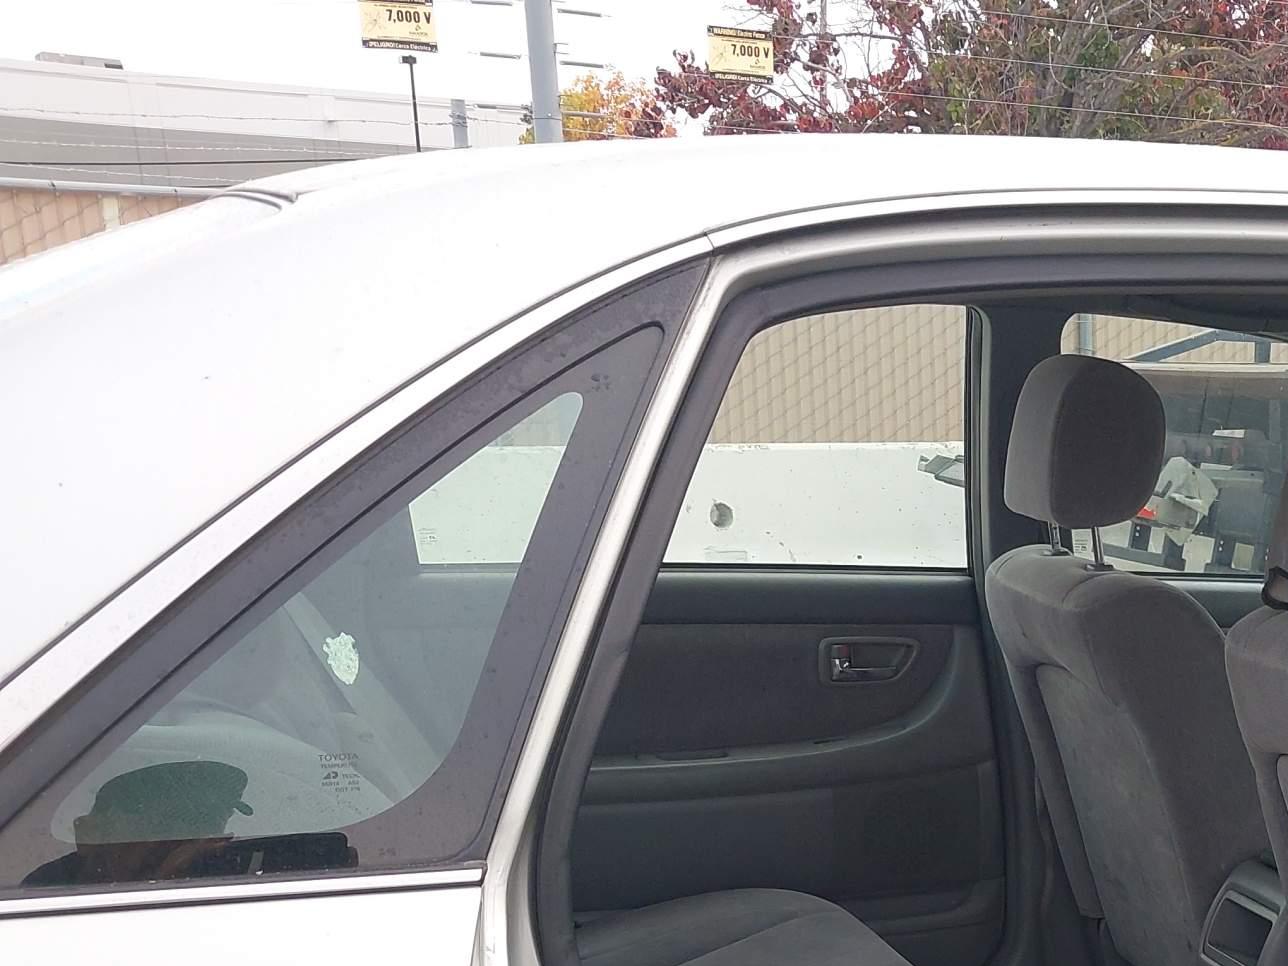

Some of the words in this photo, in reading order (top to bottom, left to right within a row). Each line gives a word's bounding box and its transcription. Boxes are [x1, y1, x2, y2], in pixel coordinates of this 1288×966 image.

[386, 9, 420, 23] 7,000
[424, 11, 431, 24] V
[731, 43, 760, 57] 7,000
[763, 47, 770, 58] V
[318, 752, 360, 762] TOYOTA
